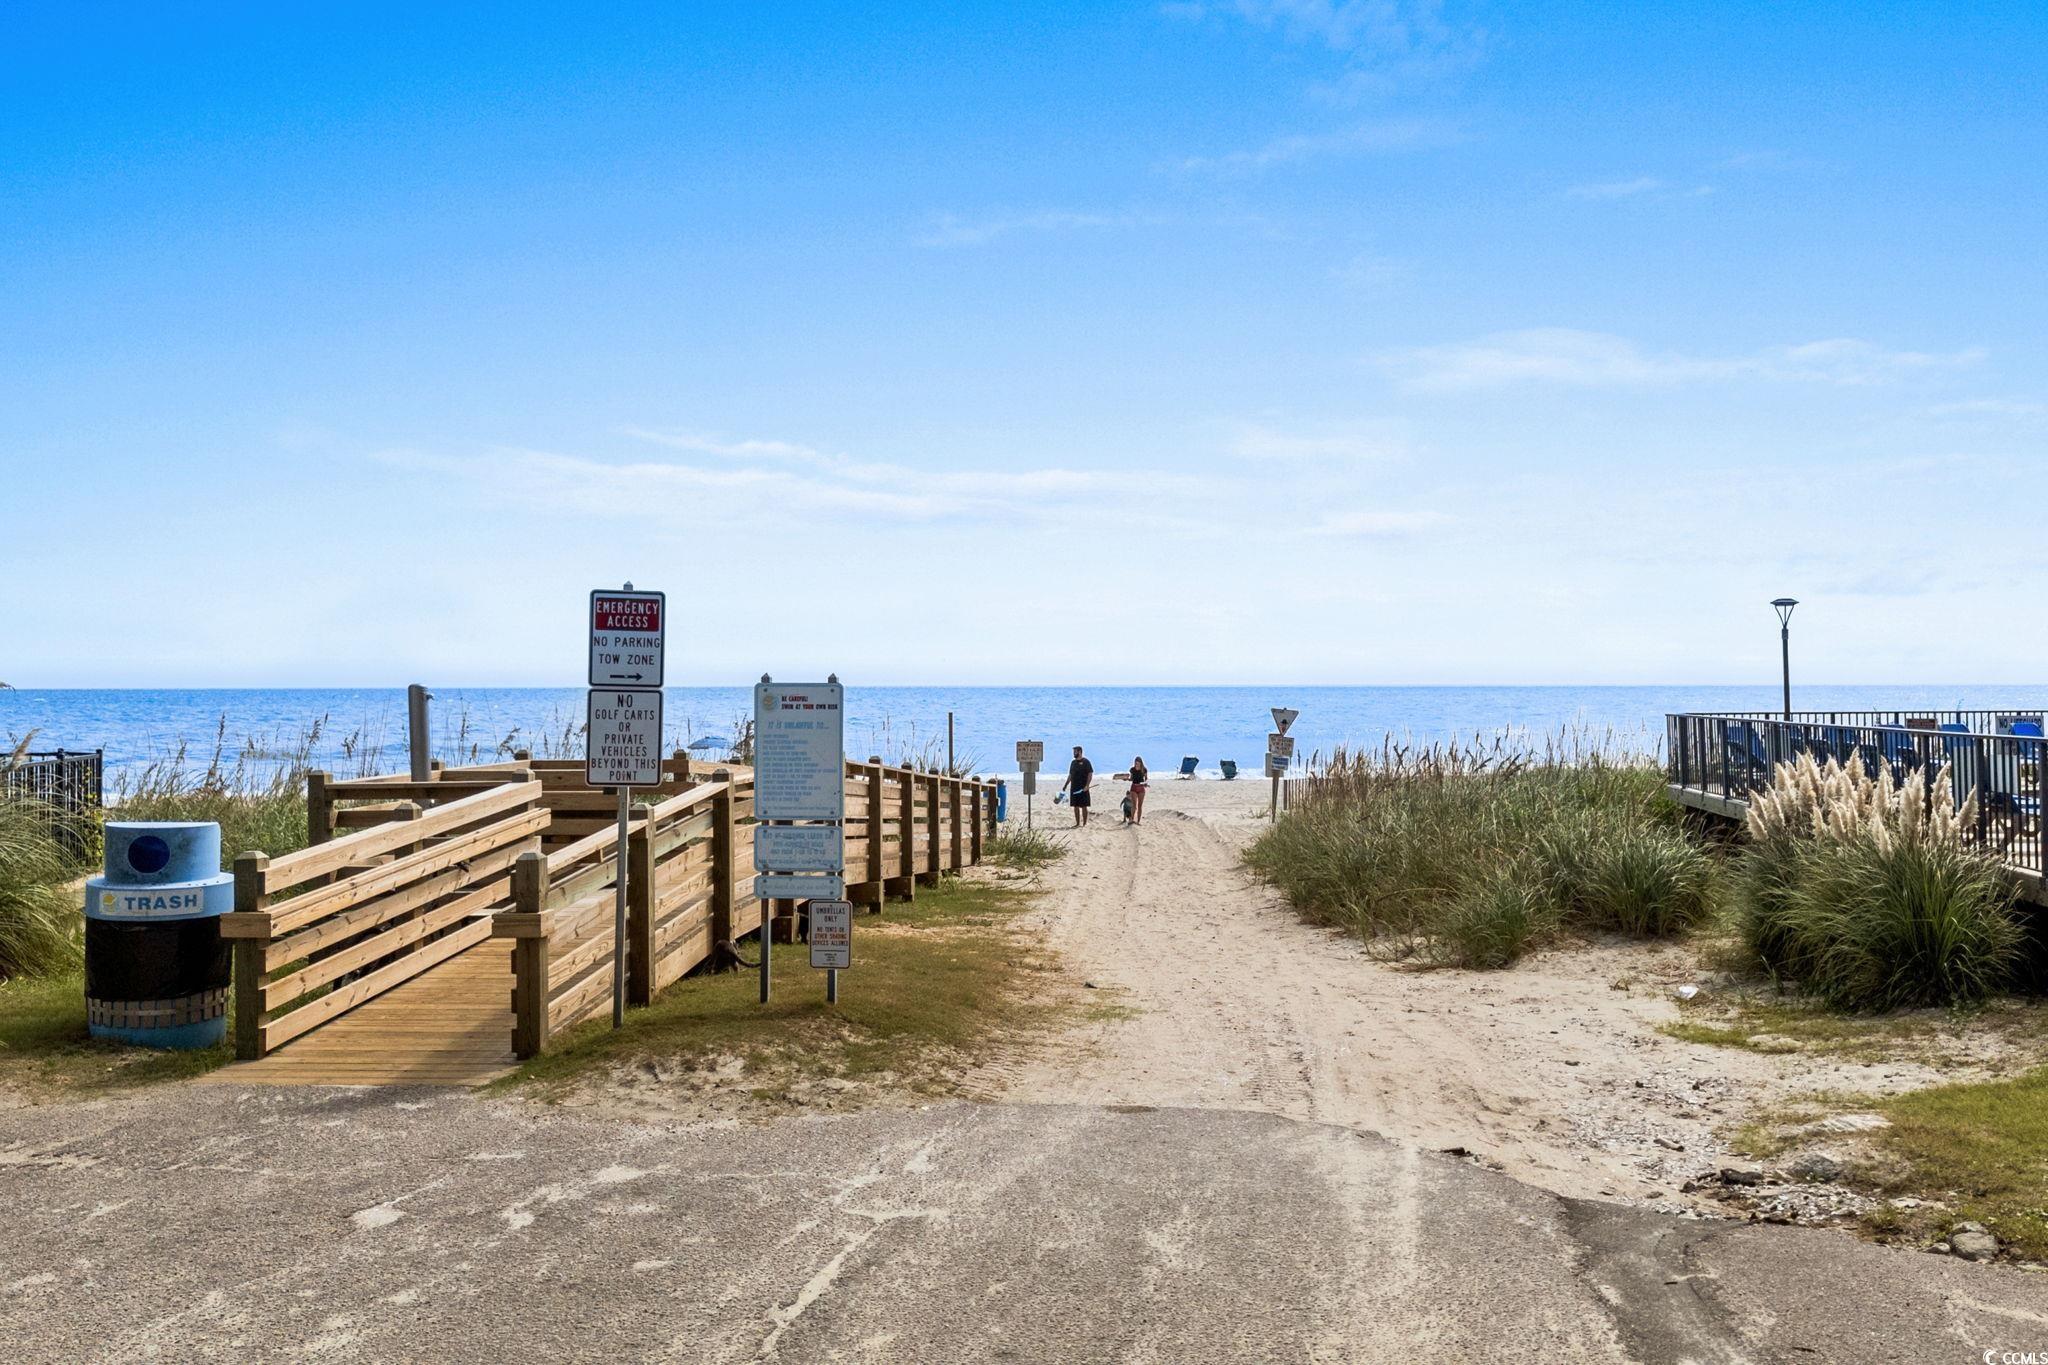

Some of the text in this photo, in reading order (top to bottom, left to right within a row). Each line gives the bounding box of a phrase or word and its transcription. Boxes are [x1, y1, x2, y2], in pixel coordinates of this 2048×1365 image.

[596, 601, 659, 615] EMERGENCY
[607, 615, 649, 628] ACCESS
[593, 636, 661, 648] NO PARKING
[598, 653, 655, 666] TOW ZONE
[617, 694, 633, 708] NO
[595, 709, 655, 721] GOLF CARTS
[618, 721, 631, 733] OR
[604, 733, 644, 745] PRIVATE
[601, 745, 648, 757] VEHICLES
[591, 758, 656, 770] BEYOND THIS
[609, 770, 638, 781] POINT
[124, 894, 198, 910] TRASH
[816, 907, 846, 915] UMBRELLAS
